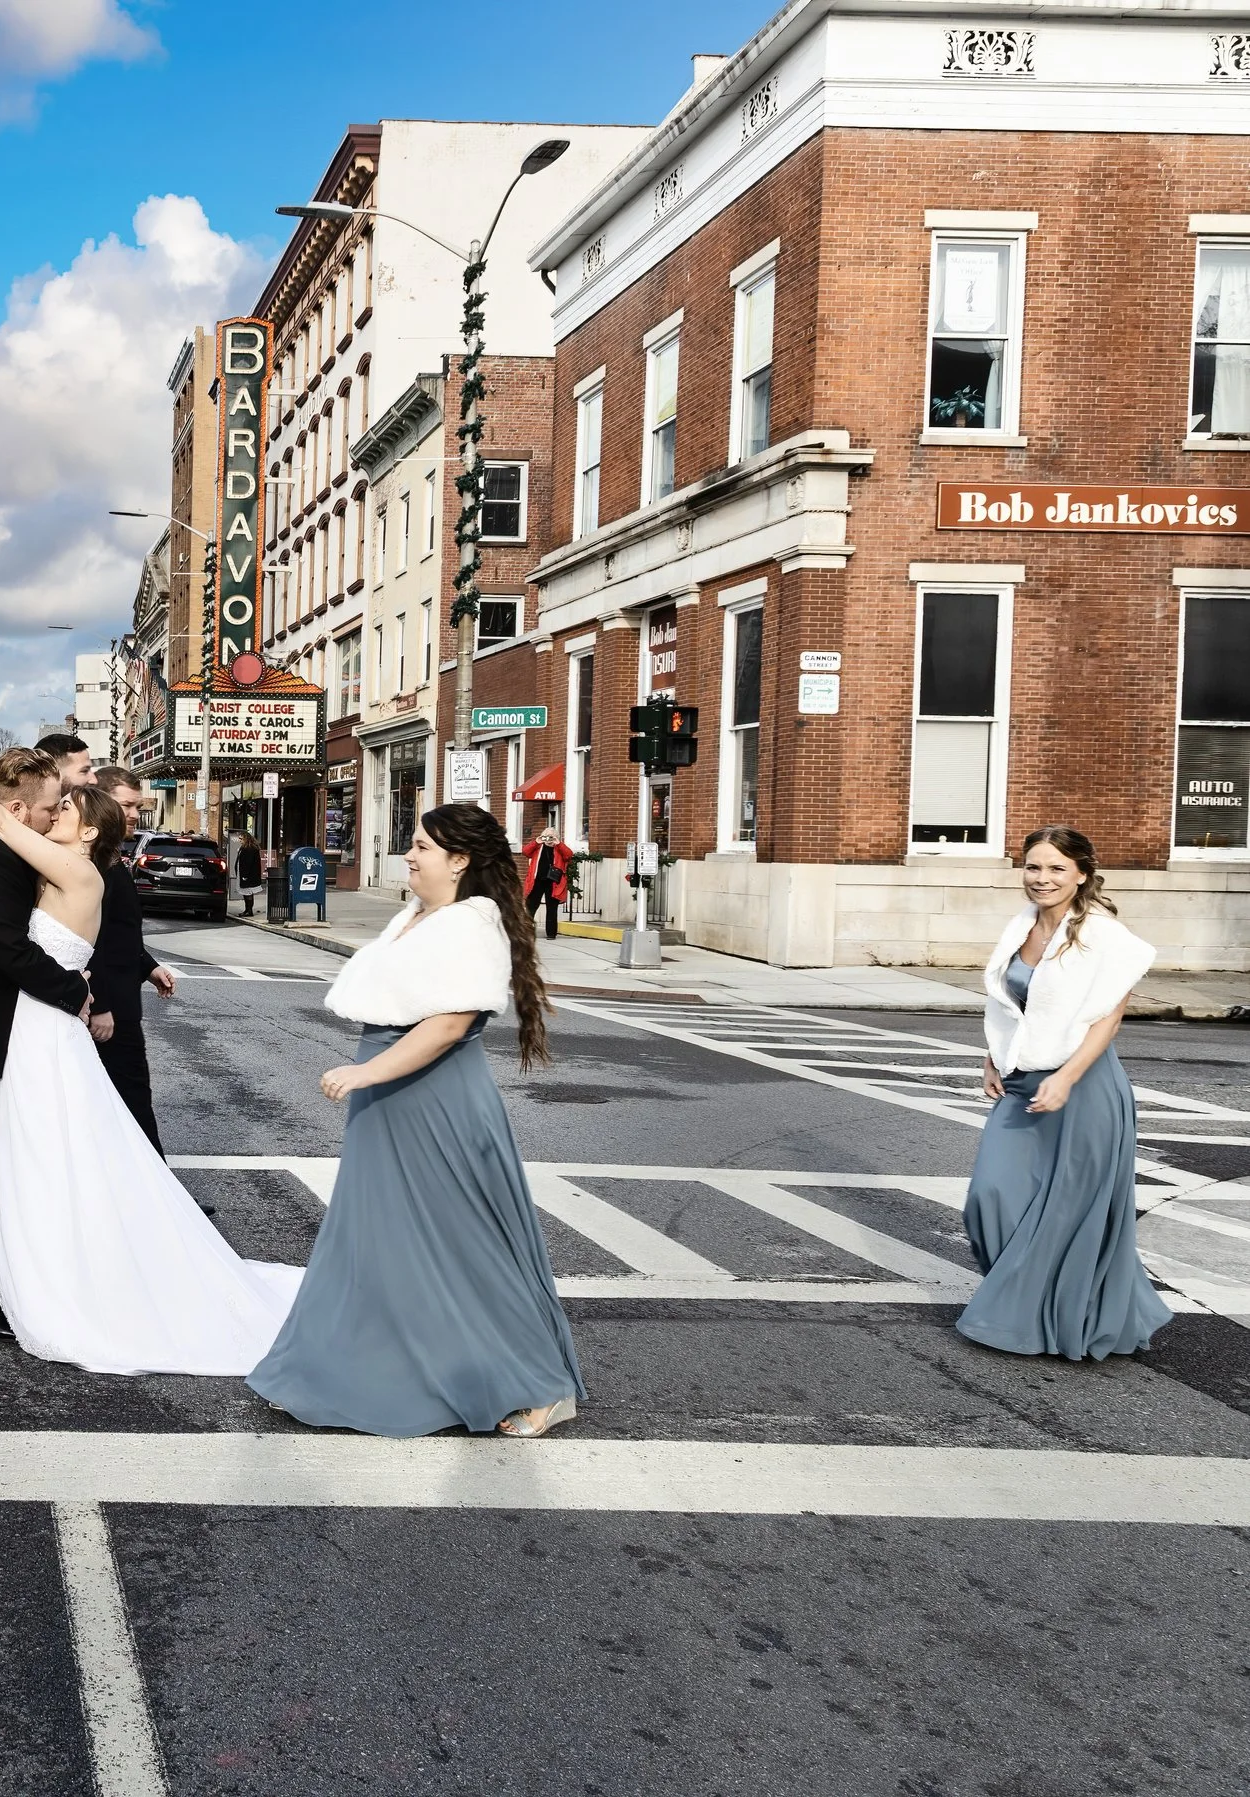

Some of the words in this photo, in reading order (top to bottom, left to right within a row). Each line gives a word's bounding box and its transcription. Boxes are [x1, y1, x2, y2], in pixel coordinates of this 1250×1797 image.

[222, 327, 266, 666] BARDAVON
[957, 491, 1034, 523] Bob
[1045, 492, 1237, 526] Jankovics
[650, 624, 664, 647] Bob
[803, 686, 813, 700] P
[248, 703, 295, 714] COLLEGE
[188, 715, 239, 726] LESONS
[244, 716, 253, 727] &
[259, 717, 305, 728] CAROLS
[478, 711, 524, 725] Cannon
[209, 729, 261, 740] ATURDAY
[175, 741, 211, 752] CELT
[261, 743, 283, 754] DEC
[286, 744, 315, 755] 16/17
[1189, 780, 1234, 793] AUTO
[534, 792, 556, 800] ATM
[1181, 795, 1242, 806] INSURANCE
